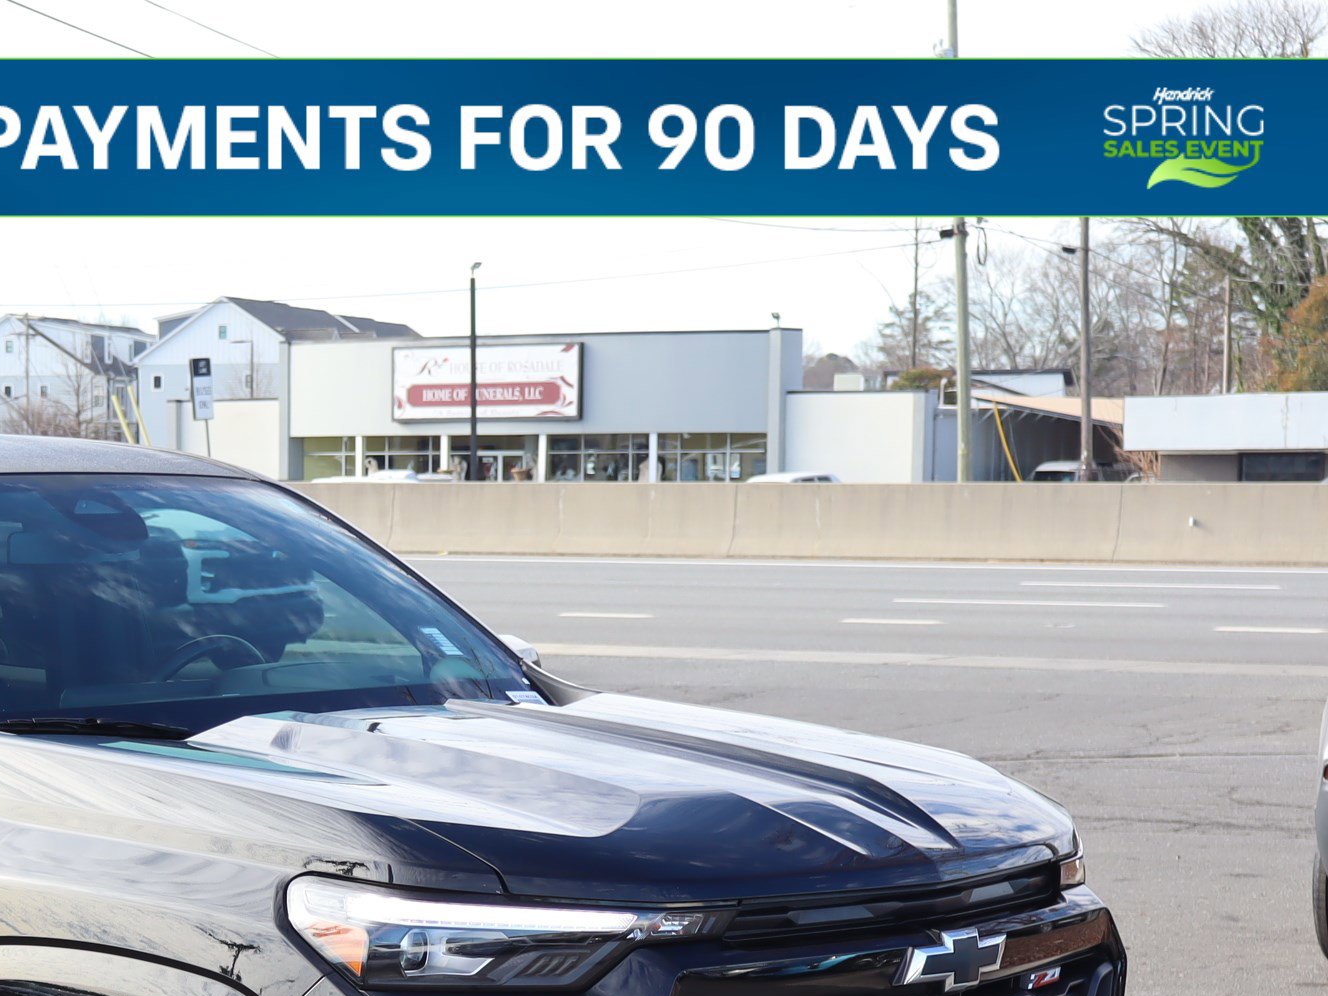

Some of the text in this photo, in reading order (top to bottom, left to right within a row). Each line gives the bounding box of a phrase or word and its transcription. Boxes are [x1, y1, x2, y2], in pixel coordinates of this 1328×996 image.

[488, 361, 506, 374] OF
[422, 388, 452, 402] HOME
[453, 388, 469, 401] OF
[524, 386, 545, 400] LLC
